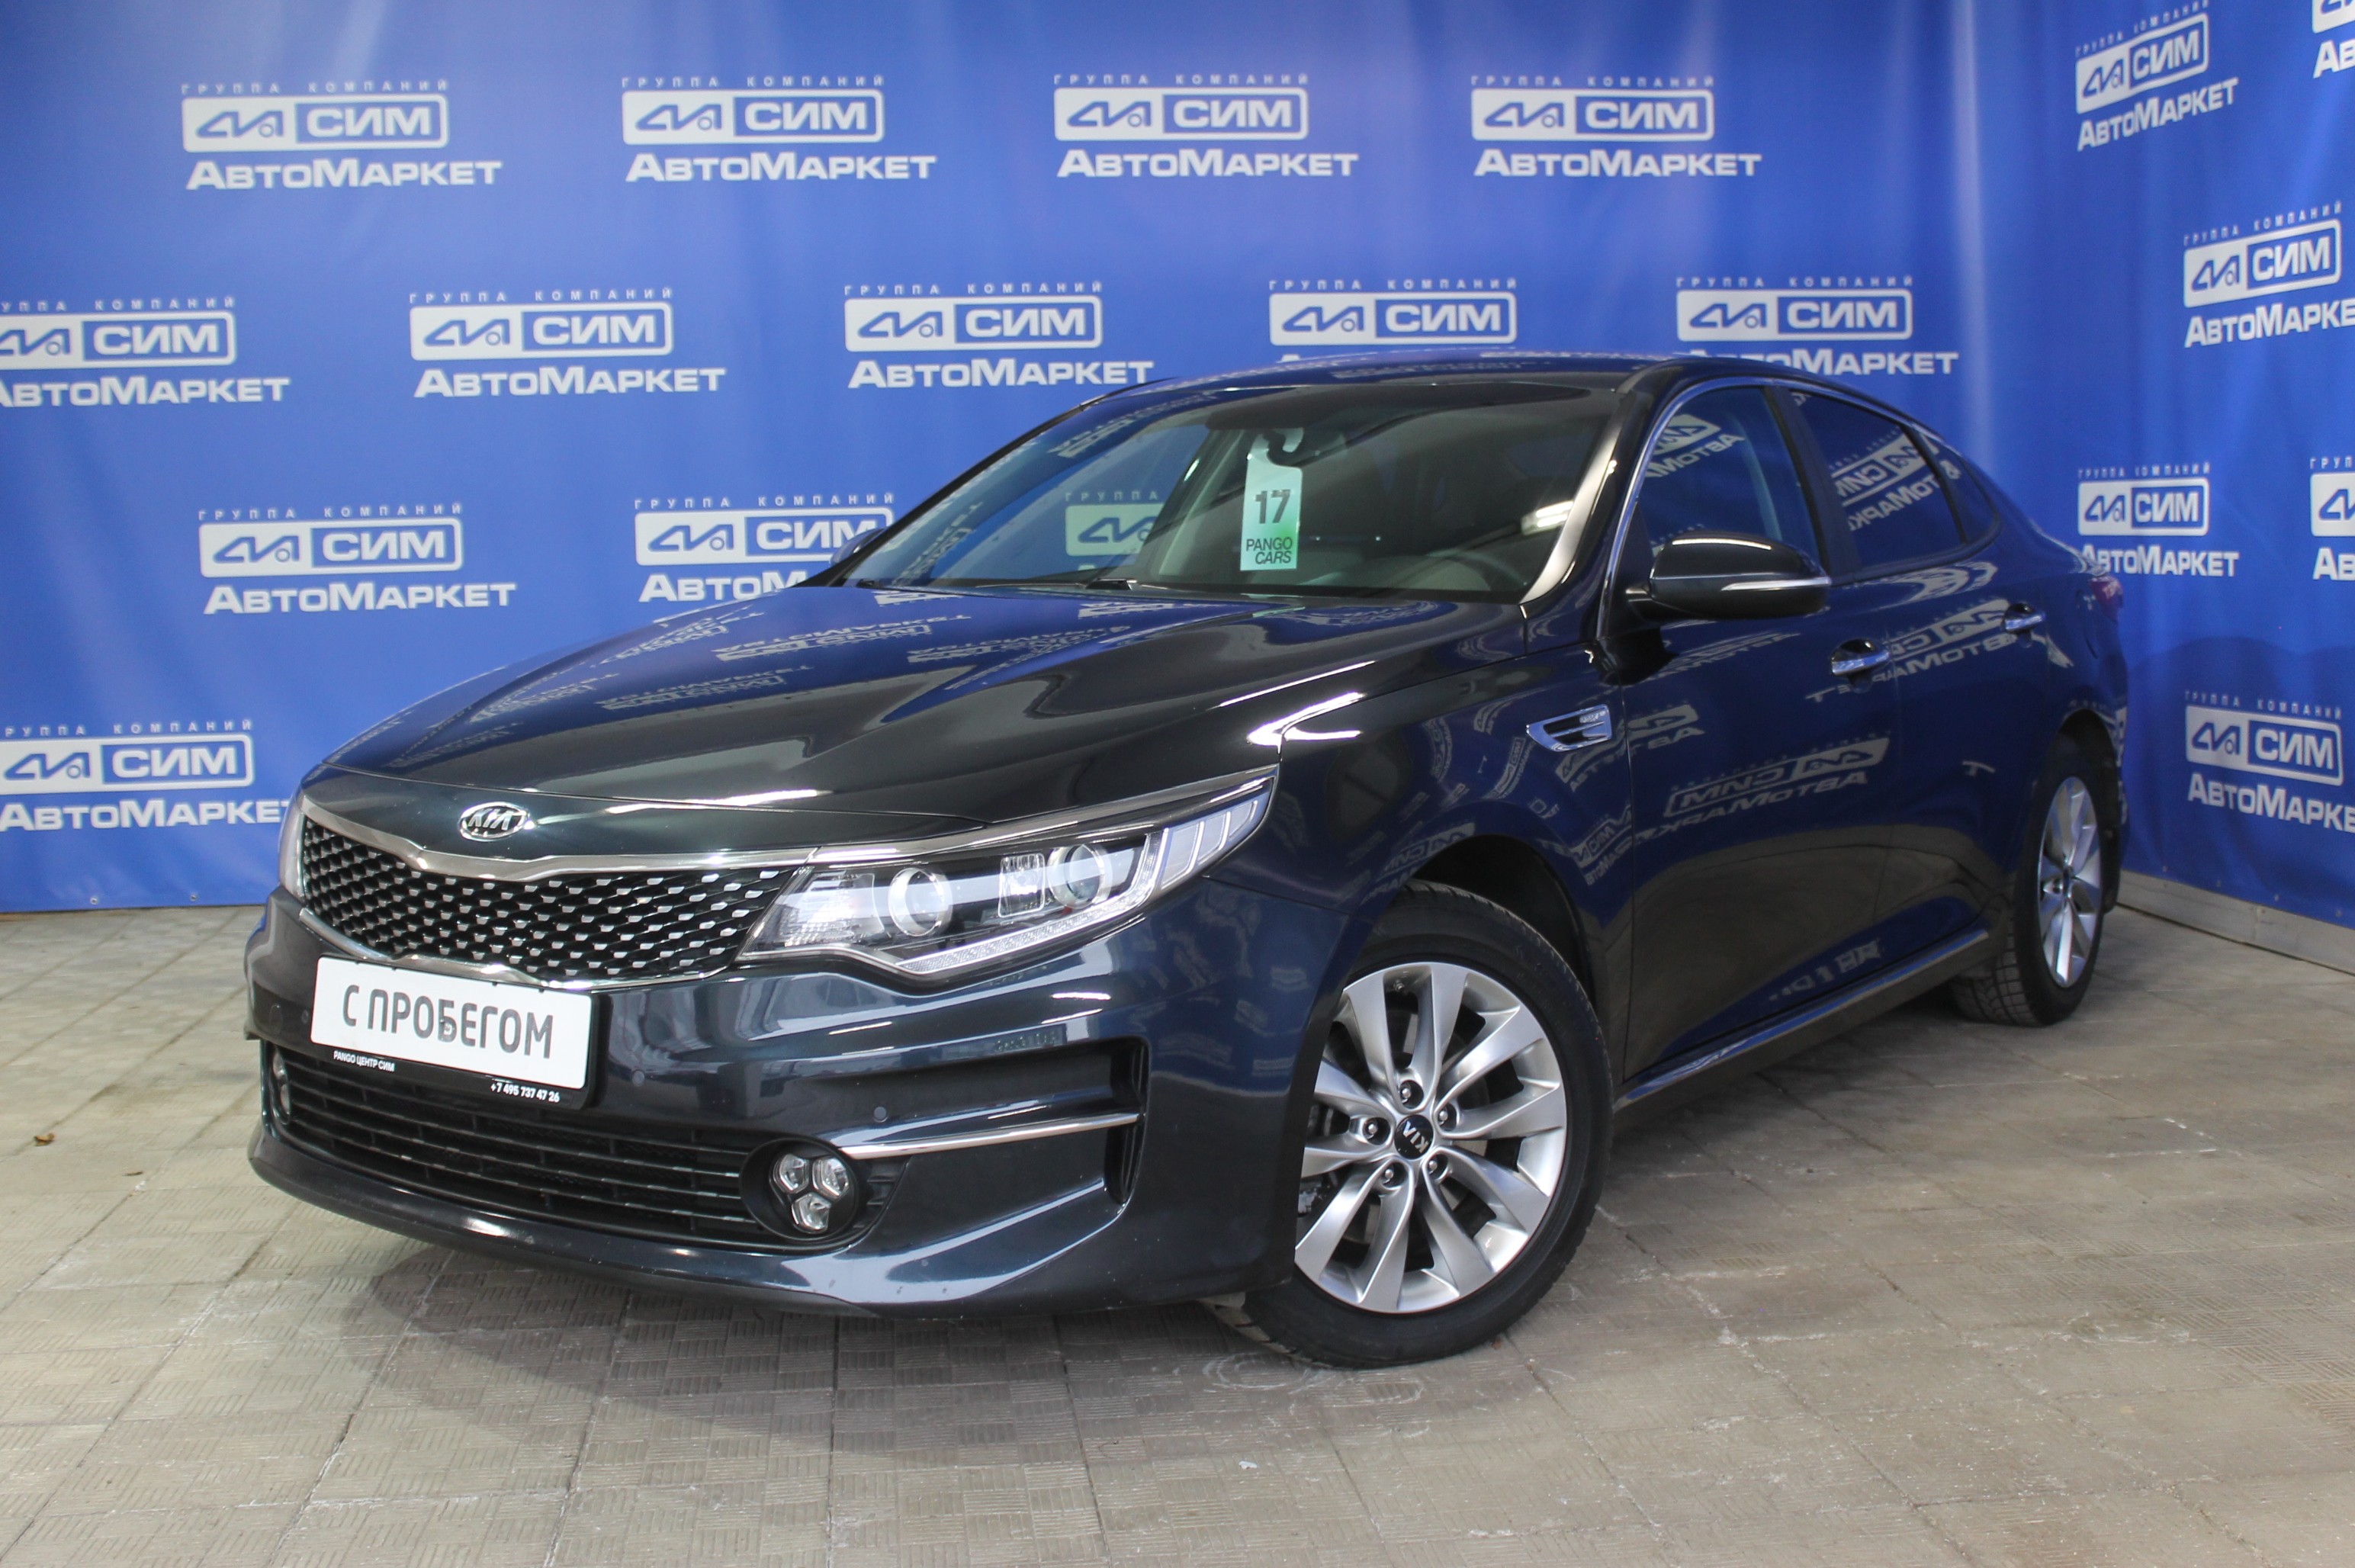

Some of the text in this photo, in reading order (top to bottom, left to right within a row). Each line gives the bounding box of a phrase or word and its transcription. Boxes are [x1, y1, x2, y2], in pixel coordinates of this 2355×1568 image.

[2133, 29, 2200, 81] СИМ
[182, 79, 448, 95] ГРУППА КОМПАНИЙ
[622, 73, 885, 88] ГРУППА КОМПАНИЙ
[1054, 72, 1308, 86] ГРУППА КОМПАНИЙ
[1472, 75, 1714, 88] ГРУППА КОМПАНИЙ
[307, 108, 432, 137] СИМ
[744, 102, 867, 131] СИМ
[1174, 100, 1291, 128] СИМ
[1586, 102, 1698, 130] СИМ
[2252, 236, 2331, 281] СИМ
[845, 281, 1102, 297] ГРУППА КОМПАНИЙ
[1269, 277, 1517, 291] ГРУППА КОМПАНИЙ
[1677, 275, 1913, 288] ГРУППА КОМПАНИЙ
[2, 295, 236, 313] УППА КОМПАНИЙ
[410, 287, 673, 304] ГРУППА КОМПАНИЙ
[965, 309, 1086, 339] СИМ
[1385, 304, 1501, 332] СИМ
[1787, 301, 1897, 329] СИМ
[94, 325, 219, 355] СИМ
[533, 315, 657, 345] СИМ
[2310, 457, 2355, 469] ГРУП
[635, 493, 895, 509] ГРУППА КОМПАНИЙ
[1066, 490, 1158, 502] ГРУППА
[1255, 490, 1290, 523] 17
[2136, 491, 2199, 522] СИМ
[199, 502, 463, 521] ГРУППА КОМПАНИЙ
[323, 532, 446, 563] СИМ
[756, 520, 876, 550] СИМ
[1246, 537, 1293, 551] PANGO
[1255, 551, 1292, 564] CARS
[5, 719, 253, 737] РУППА КОМПАНИЙ
[2255, 728, 2334, 770] СИМ
[112, 747, 237, 779] СИМ
[467, 808, 515, 831] KIA
[342, 985, 554, 1059] С ПРОБЕГОМ
[333, 1050, 396, 1073] PANGO ЦЕНТР СИМ
[503, 1084, 519, 1097] 495
[520, 1087, 535, 1099] 737
[535, 1090, 548, 1101] 47
[548, 1091, 561, 1104] 26
[1402, 1120, 1429, 1154] KIA
